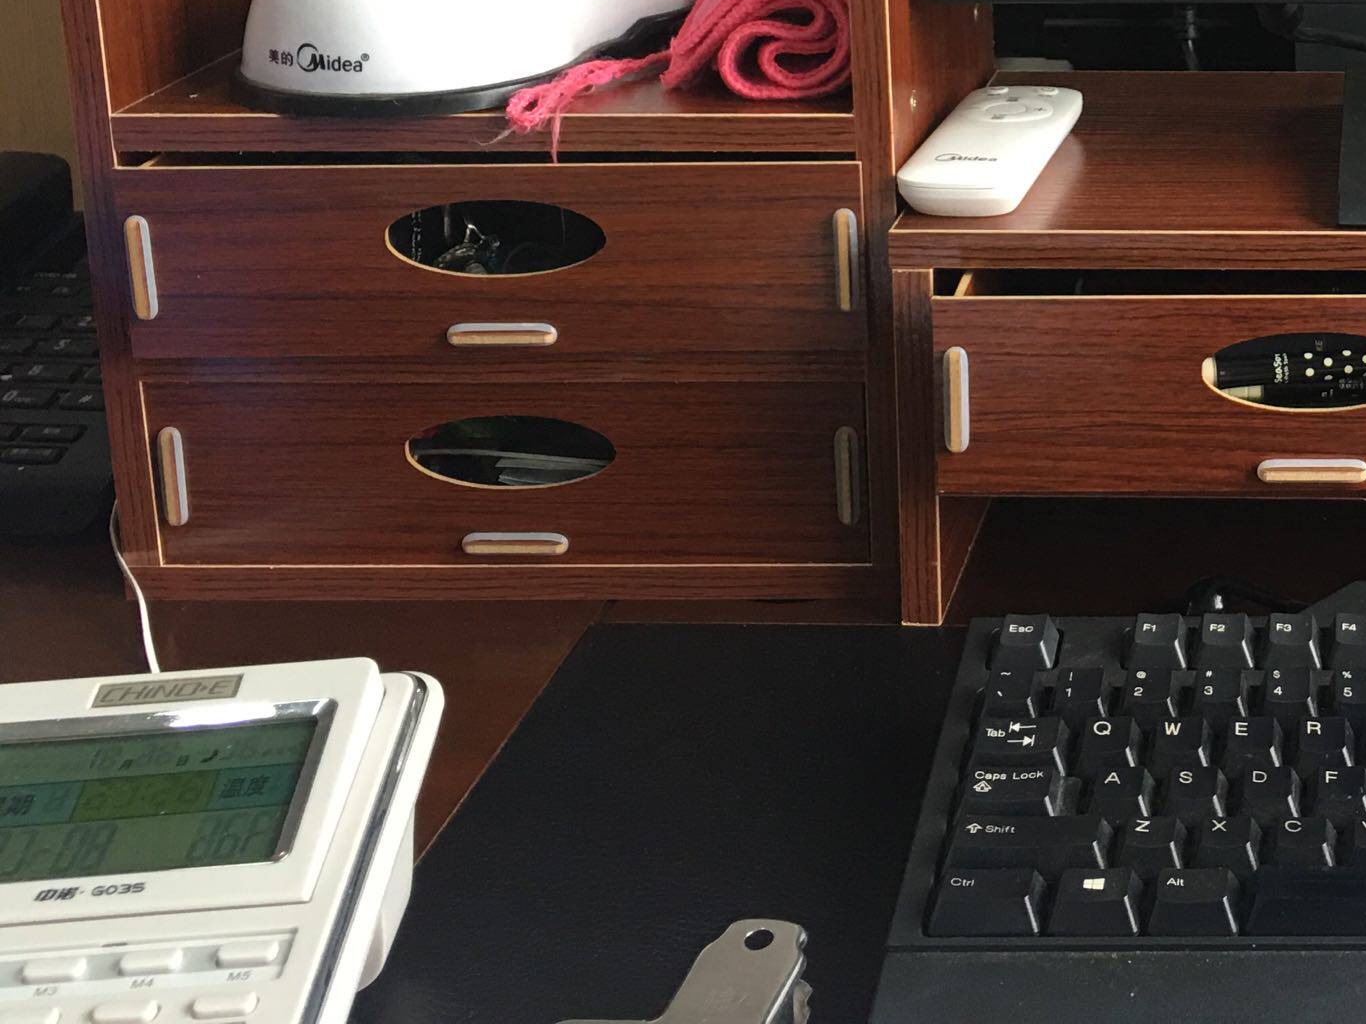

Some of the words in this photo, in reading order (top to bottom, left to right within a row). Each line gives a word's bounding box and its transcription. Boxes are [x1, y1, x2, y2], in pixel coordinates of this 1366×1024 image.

[268, 49, 294, 67] 美的
[934, 152, 998, 163] Midea
[1008, 624, 1034, 633] Esc
[1142, 623, 1157, 632] F1
[1209, 623, 1226, 632] F2
[1276, 623, 1292, 632] F3
[1341, 622, 1357, 632] F4
[1065, 687, 1072, 698] 1
[1133, 686, 1144, 697] 2
[1203, 685, 1213, 695] 3
[1273, 686, 1283, 696] 4
[1343, 687, 1353, 697] 5
[985, 728, 1006, 738] Tab
[1093, 720, 1112, 736] Q
[1164, 721, 1182, 736] W
[1235, 721, 1248, 736] E
[1306, 720, 1322, 735] R
[974, 770, 1007, 784] Caps
[1012, 770, 1044, 780] Lock
[1104, 772, 1121, 785] A
[1179, 771, 1193, 784] S
[1252, 770, 1268, 783] D
[1325, 770, 1338, 784] F
[985, 824, 1015, 834] Shift
[1134, 819, 1151, 833] Z
[1211, 819, 1227, 832] X
[1284, 820, 1302, 833] C
[950, 877, 975, 887] Ctrl
[1166, 877, 1185, 887] Alt
[226, 970, 252, 983] M5
[129, 977, 156, 990] M4
